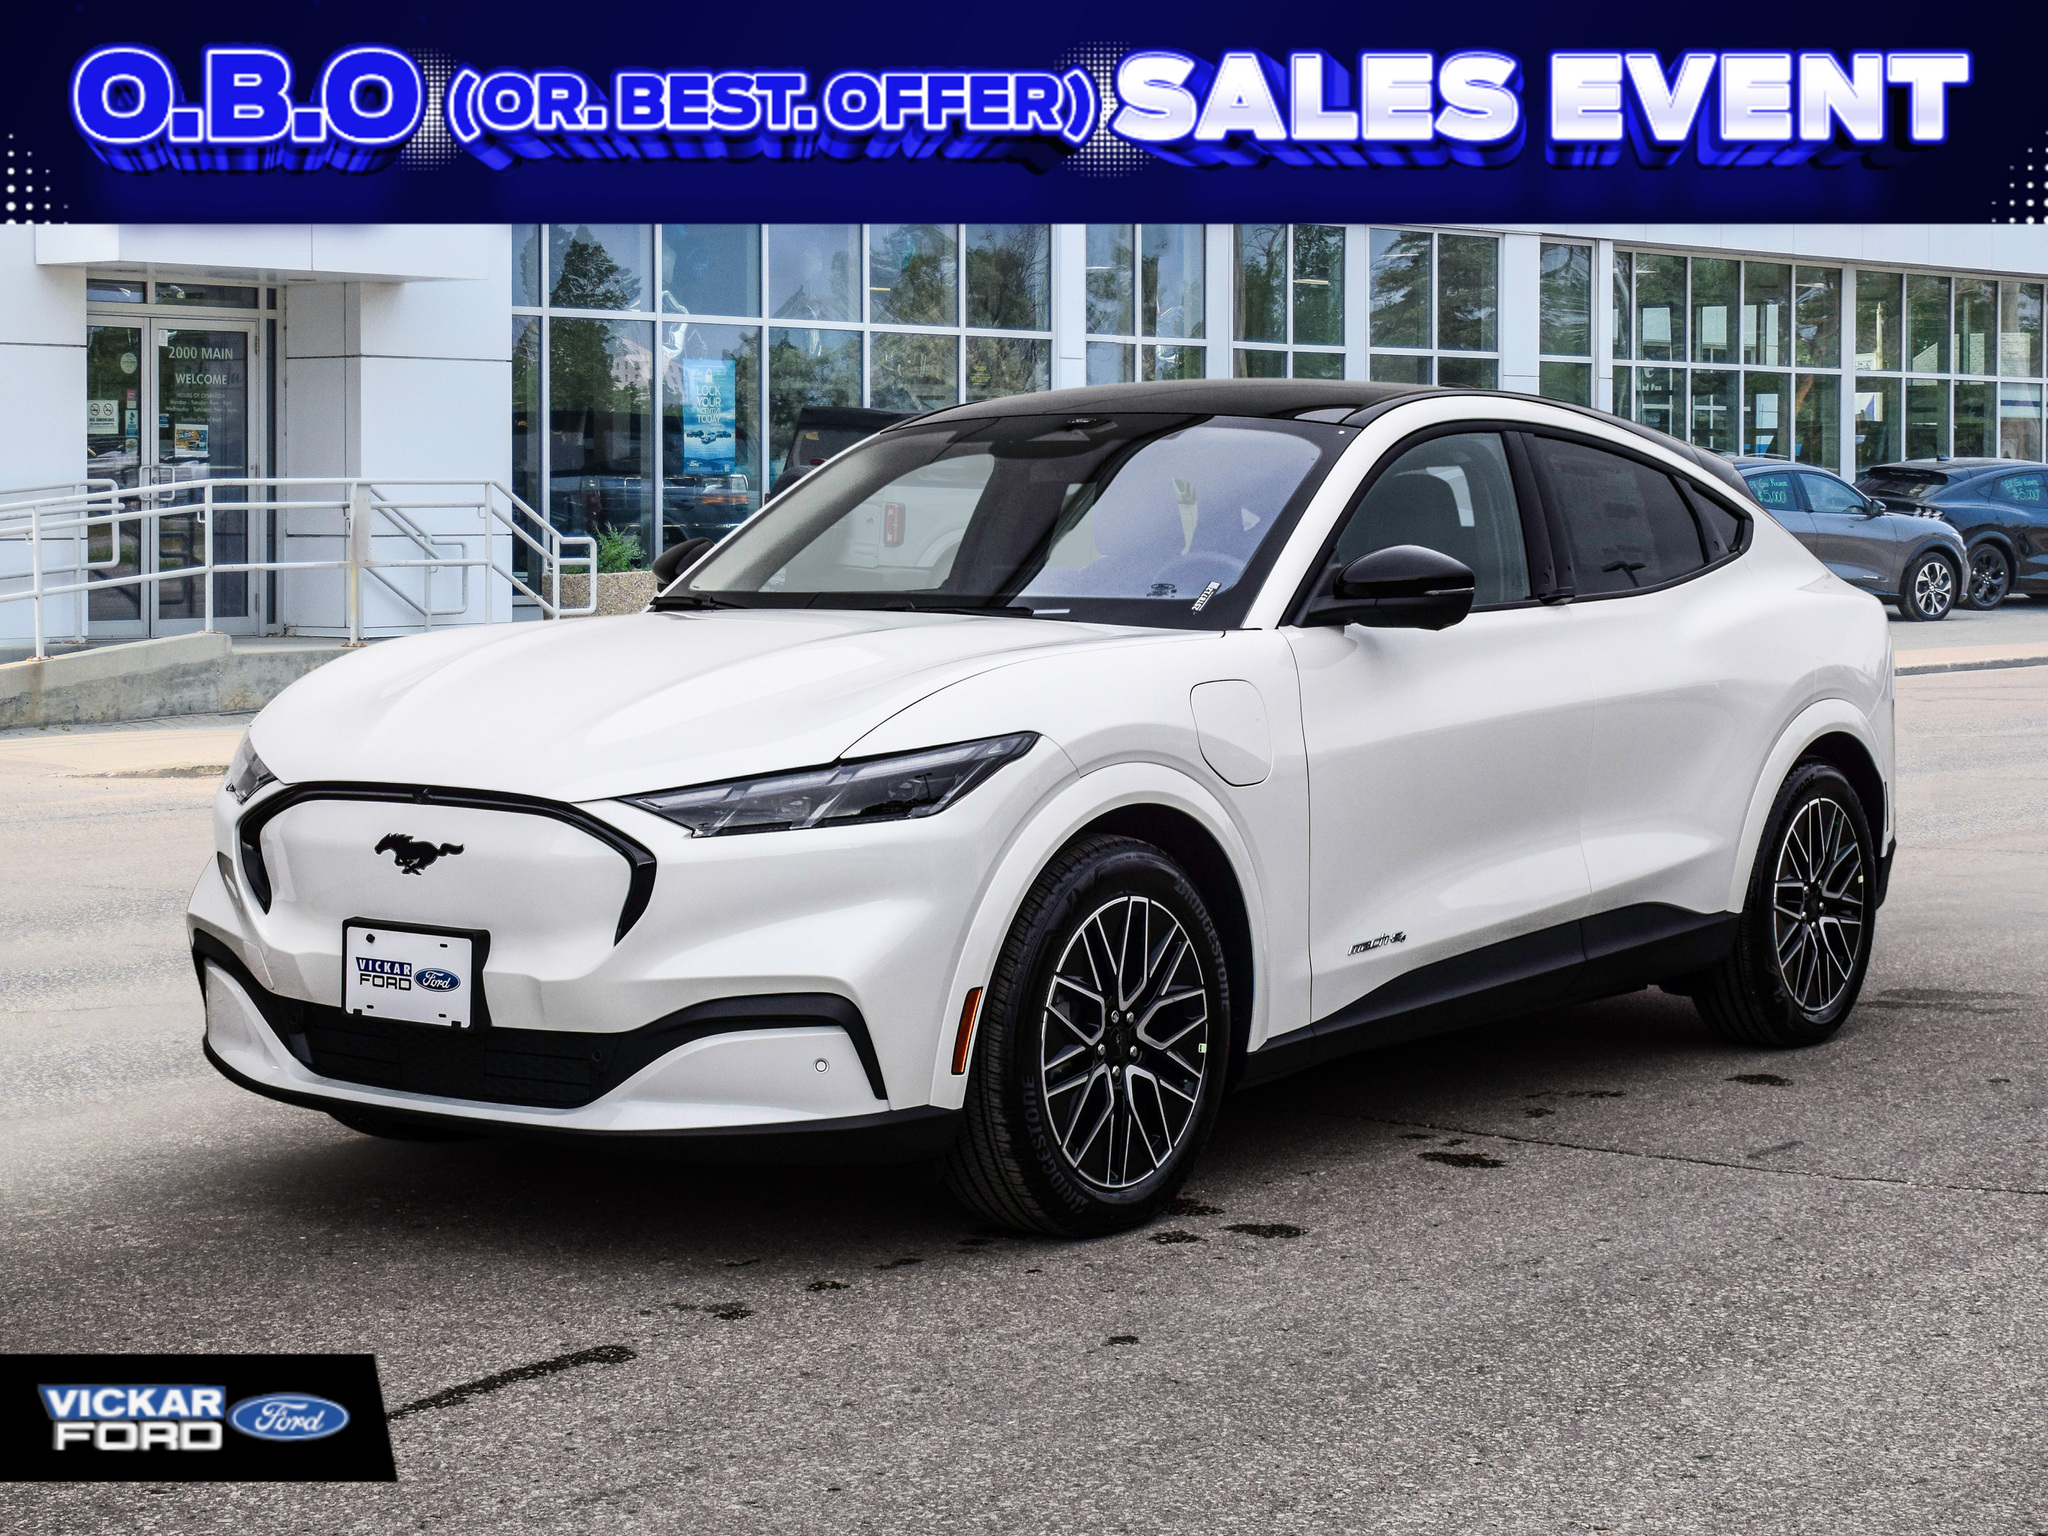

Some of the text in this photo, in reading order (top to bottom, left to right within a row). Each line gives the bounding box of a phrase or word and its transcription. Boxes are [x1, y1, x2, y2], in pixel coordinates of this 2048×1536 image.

[168, 346, 233, 360] 2000 MAIN
[175, 373, 227, 385] WELCOME
[696, 385, 721, 396] LOCK
[696, 397, 721, 407] YOUR
[697, 415, 720, 424] TODAY
[358, 958, 411, 976] VICKAR
[359, 971, 451, 991] FORD Ford
